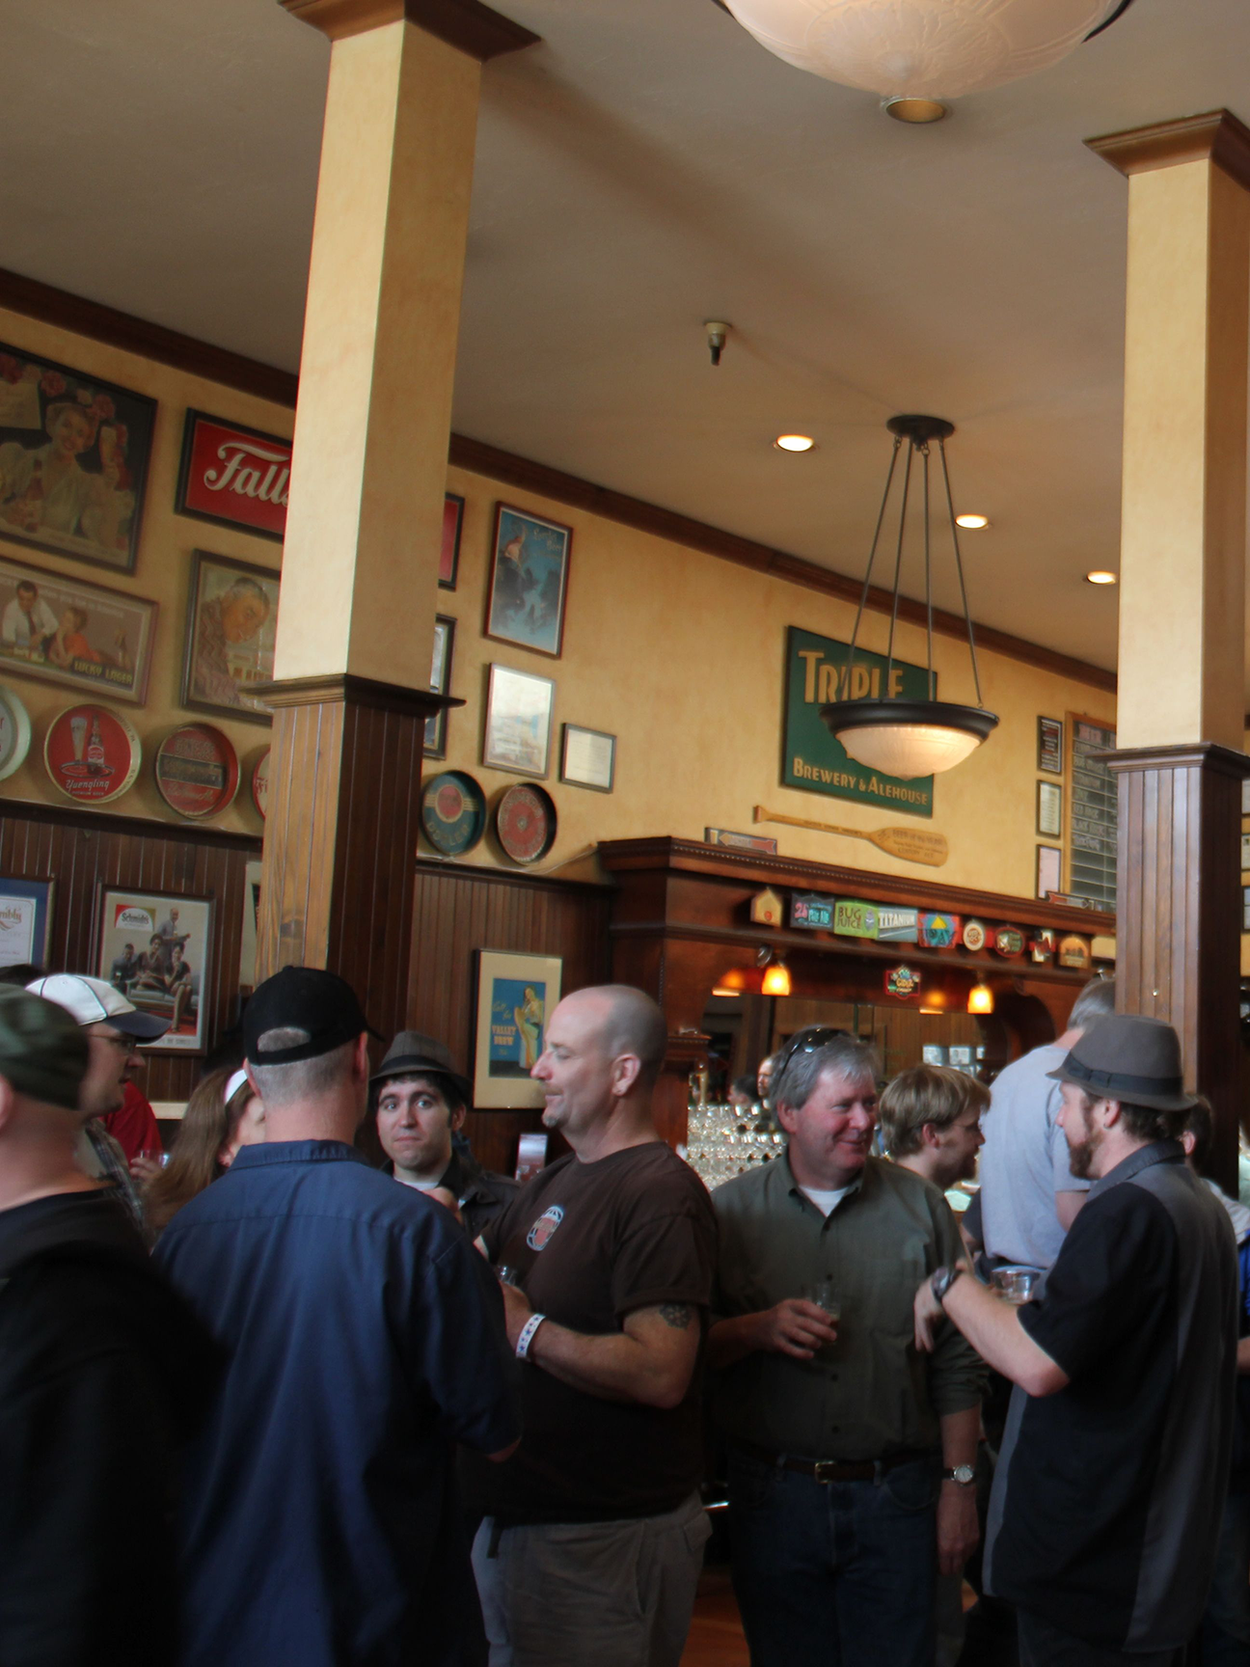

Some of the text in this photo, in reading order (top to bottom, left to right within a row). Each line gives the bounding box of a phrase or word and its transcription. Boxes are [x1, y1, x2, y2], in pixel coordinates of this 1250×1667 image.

[74, 660, 133, 685] LUCKY LAGER
[65, 779, 110, 793] Yuengling
[793, 757, 928, 806] BREWERY & ALEHOUSE
[839, 906, 861, 920] BUG
[837, 918, 861, 930] JUICE
[879, 912, 915, 929] TITANIUM
[492, 1025, 516, 1035] VALLEY
